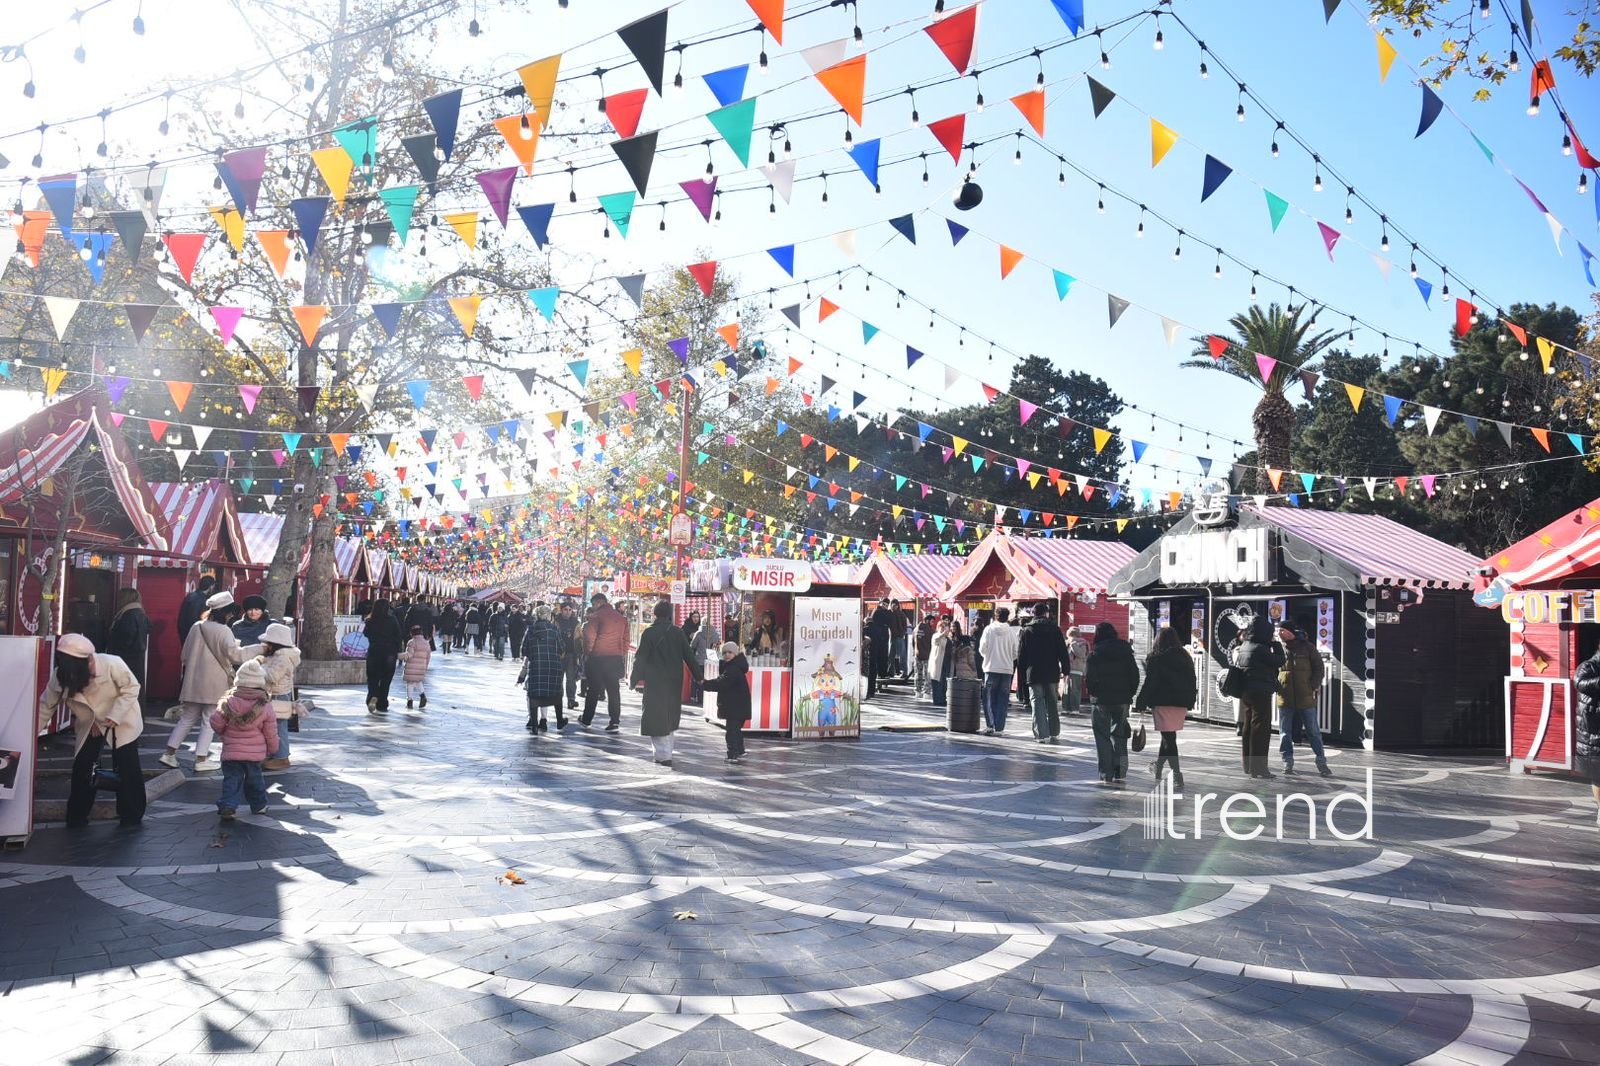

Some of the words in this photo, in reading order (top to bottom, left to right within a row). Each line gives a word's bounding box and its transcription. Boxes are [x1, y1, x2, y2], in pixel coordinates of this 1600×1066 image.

[751, 570, 795, 587] MISIR
[1502, 592, 1600, 623] COFF
[800, 625, 853, 642] Qarğıdalı
